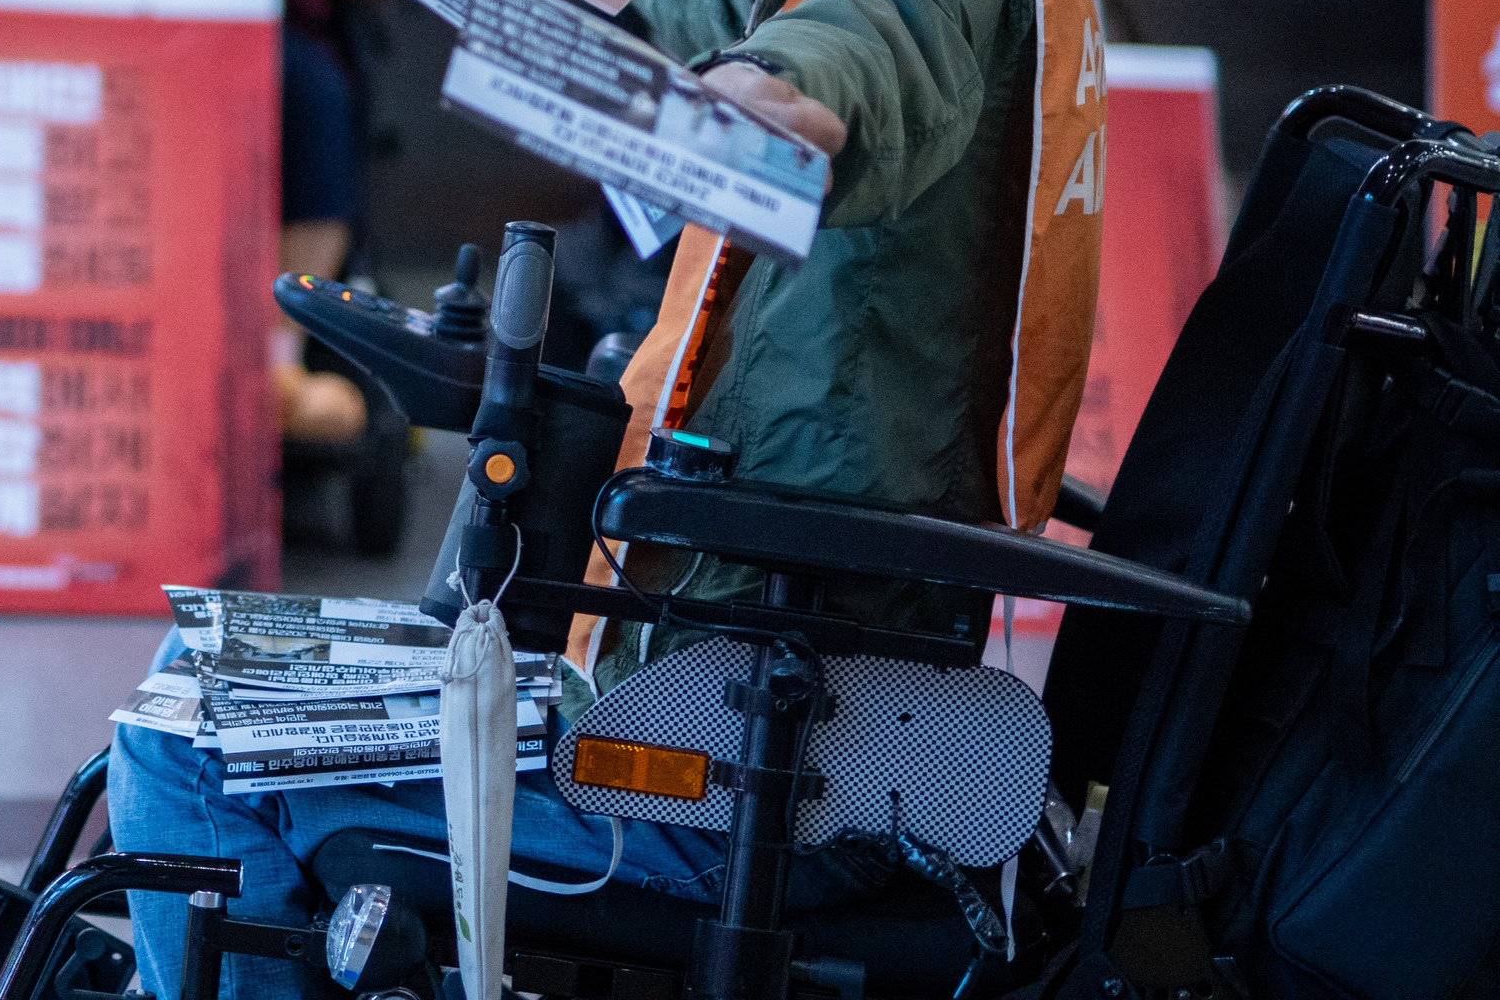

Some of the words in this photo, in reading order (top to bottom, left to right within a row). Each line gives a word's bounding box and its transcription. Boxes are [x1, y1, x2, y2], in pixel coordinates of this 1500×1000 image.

[353, 635, 385, 644] 이재명
[268, 676, 328, 685] 대통령님!
[138, 703, 175, 718] 이재명
[360, 701, 384, 710] 21대
[262, 707, 295, 715] 약자의
[221, 717, 274, 727] 국무총리는
[275, 713, 309, 722] 김민석
[251, 726, 326, 739] 해결합시다!
[330, 722, 414, 734] 이동권만큼은
[311, 732, 400, 744] 외쳐왔습니다.
[342, 745, 386, 754] 이동하는
[388, 740, 431, 751] 시민으로
[293, 747, 339, 757] 민주주의!
[226, 761, 264, 773] 이제는
[268, 756, 318, 771] 민주당이
[321, 752, 359, 766] 장애인
[363, 750, 401, 763] 이동권
[250, 780, 276, 788] 홈페이지
[277, 778, 314, 786] sadd.or.kr
